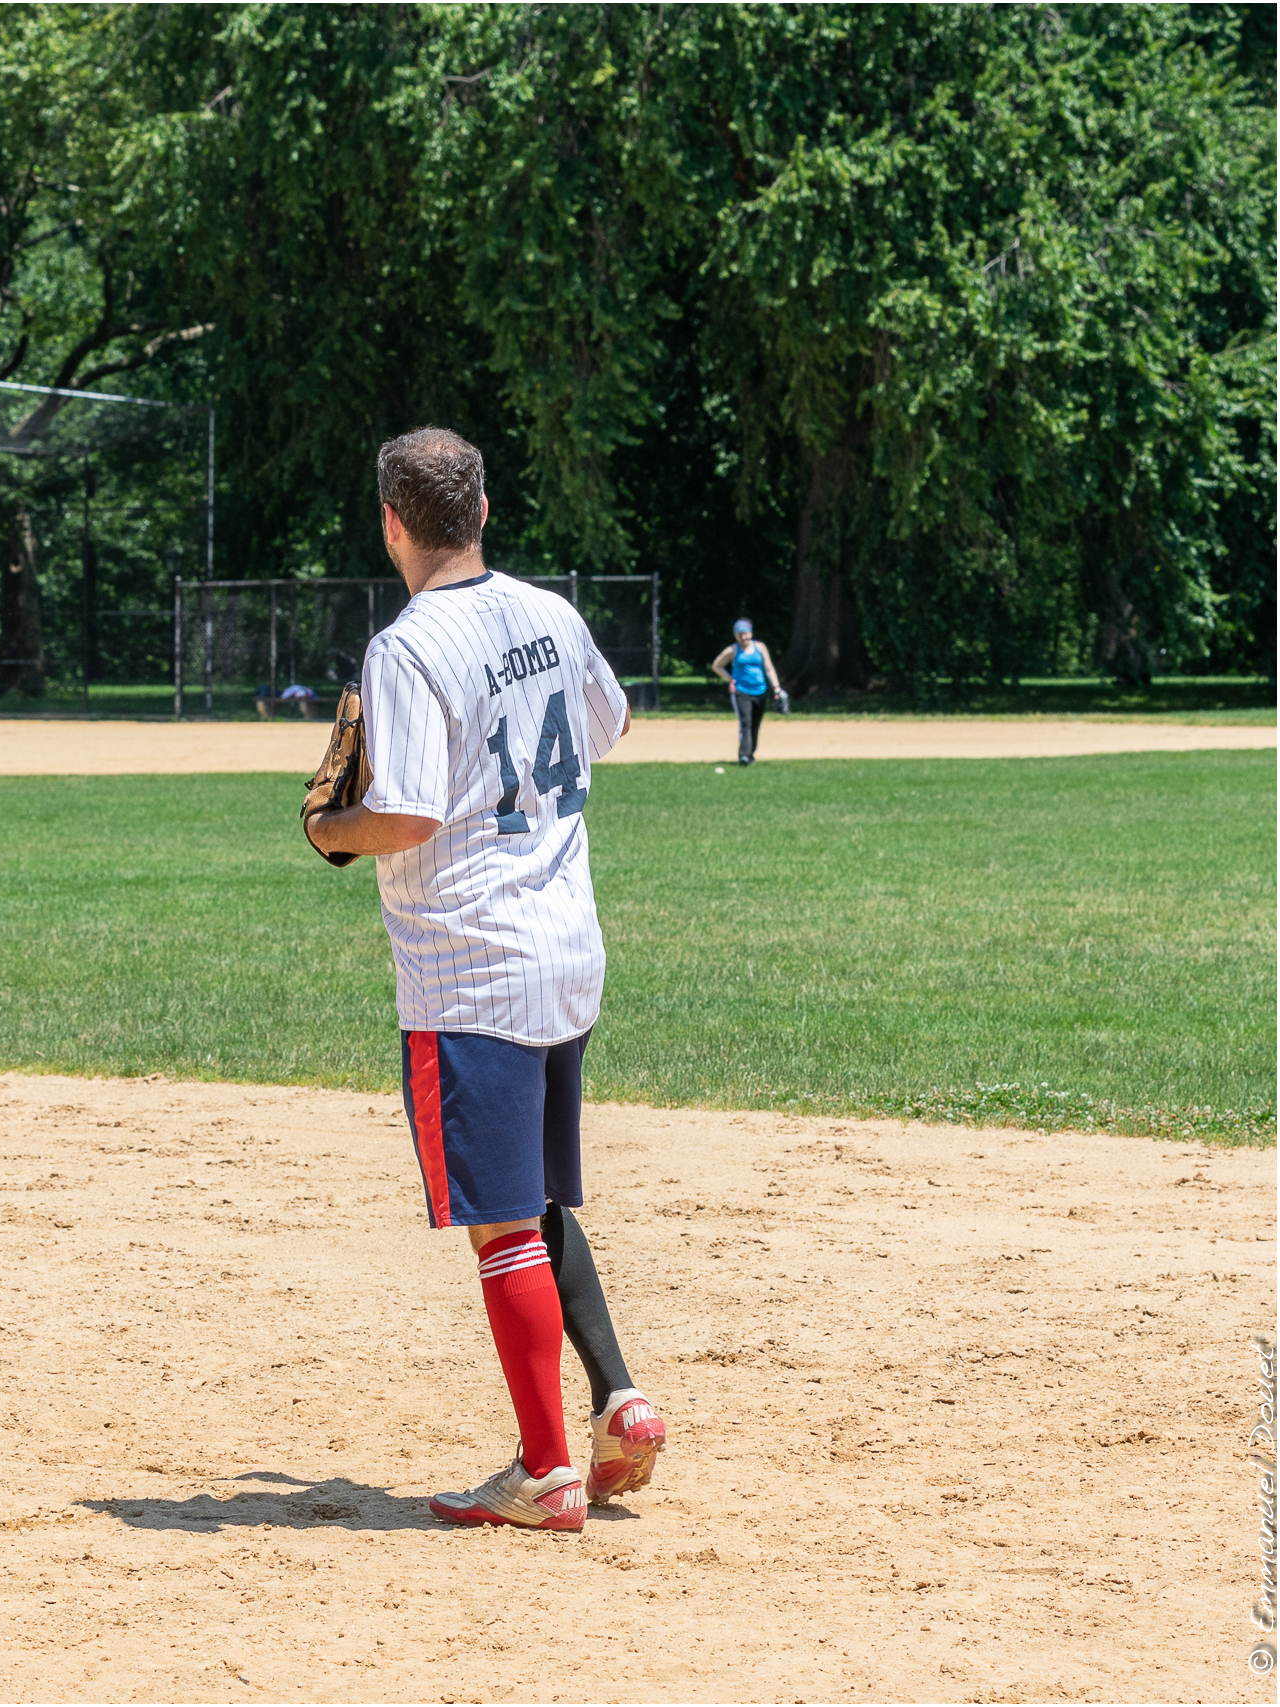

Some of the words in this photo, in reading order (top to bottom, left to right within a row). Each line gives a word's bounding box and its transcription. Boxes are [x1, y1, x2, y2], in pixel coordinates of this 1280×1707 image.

[486, 689, 587, 835] 14
[622, 1404, 658, 1430] NIK
[562, 1487, 588, 1510] NIK
